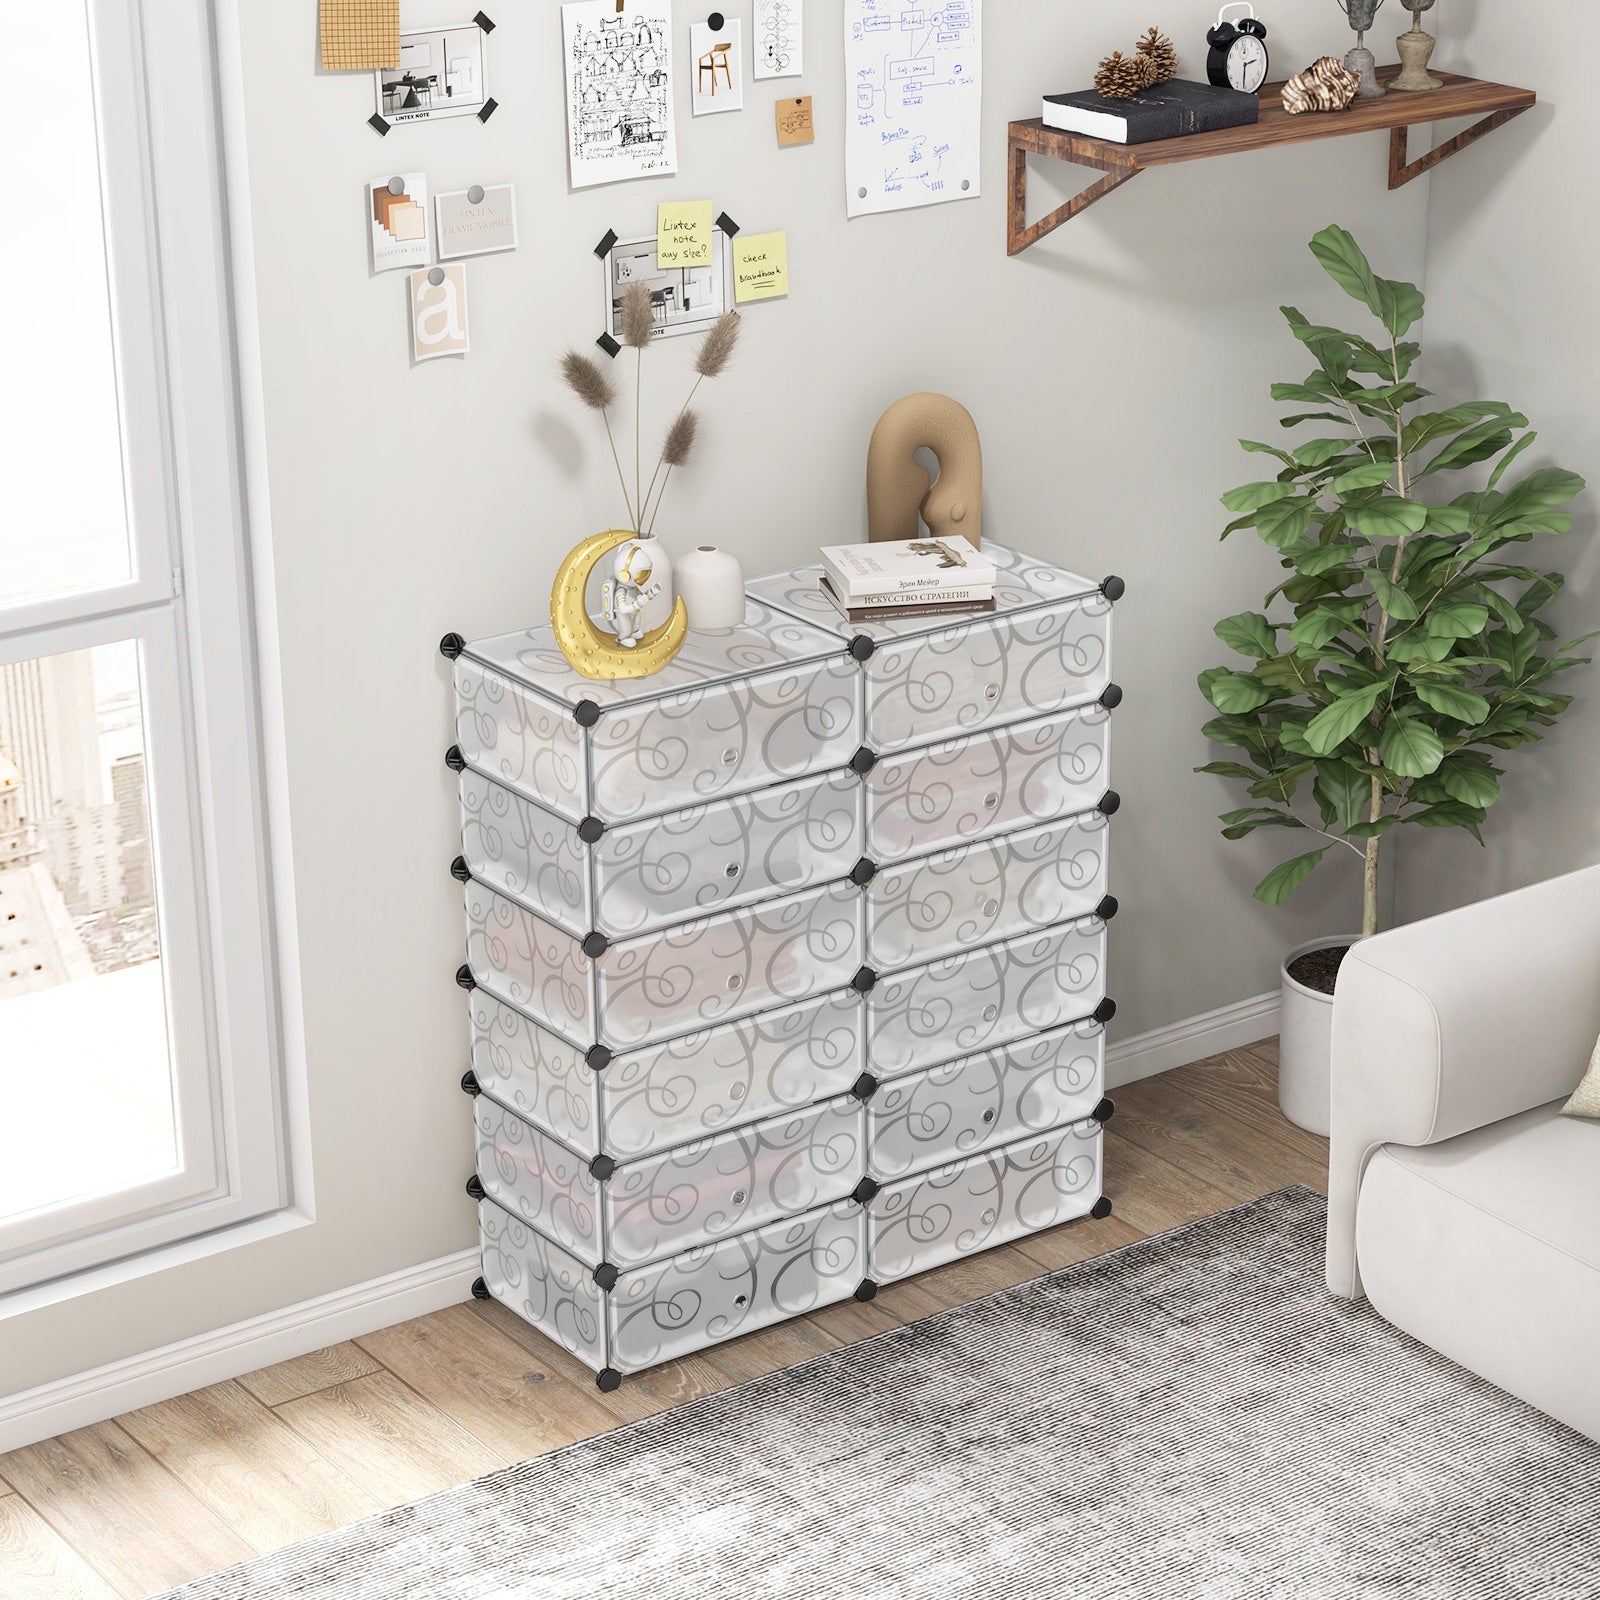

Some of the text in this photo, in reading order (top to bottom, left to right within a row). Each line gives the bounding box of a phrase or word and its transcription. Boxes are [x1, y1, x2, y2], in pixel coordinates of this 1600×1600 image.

[459, 207, 495, 219] LINTEX
[443, 217, 512, 235] FRAME MOBILE
[663, 218, 696, 231] Lintex
[673, 235, 697, 244] note
[661, 244, 707, 261] any size?
[416, 277, 465, 345] a
[899, 579, 940, 589] Эрин Мейер
[864, 590, 969, 604] ИСКУССТВО СТРАТЕГИИ
